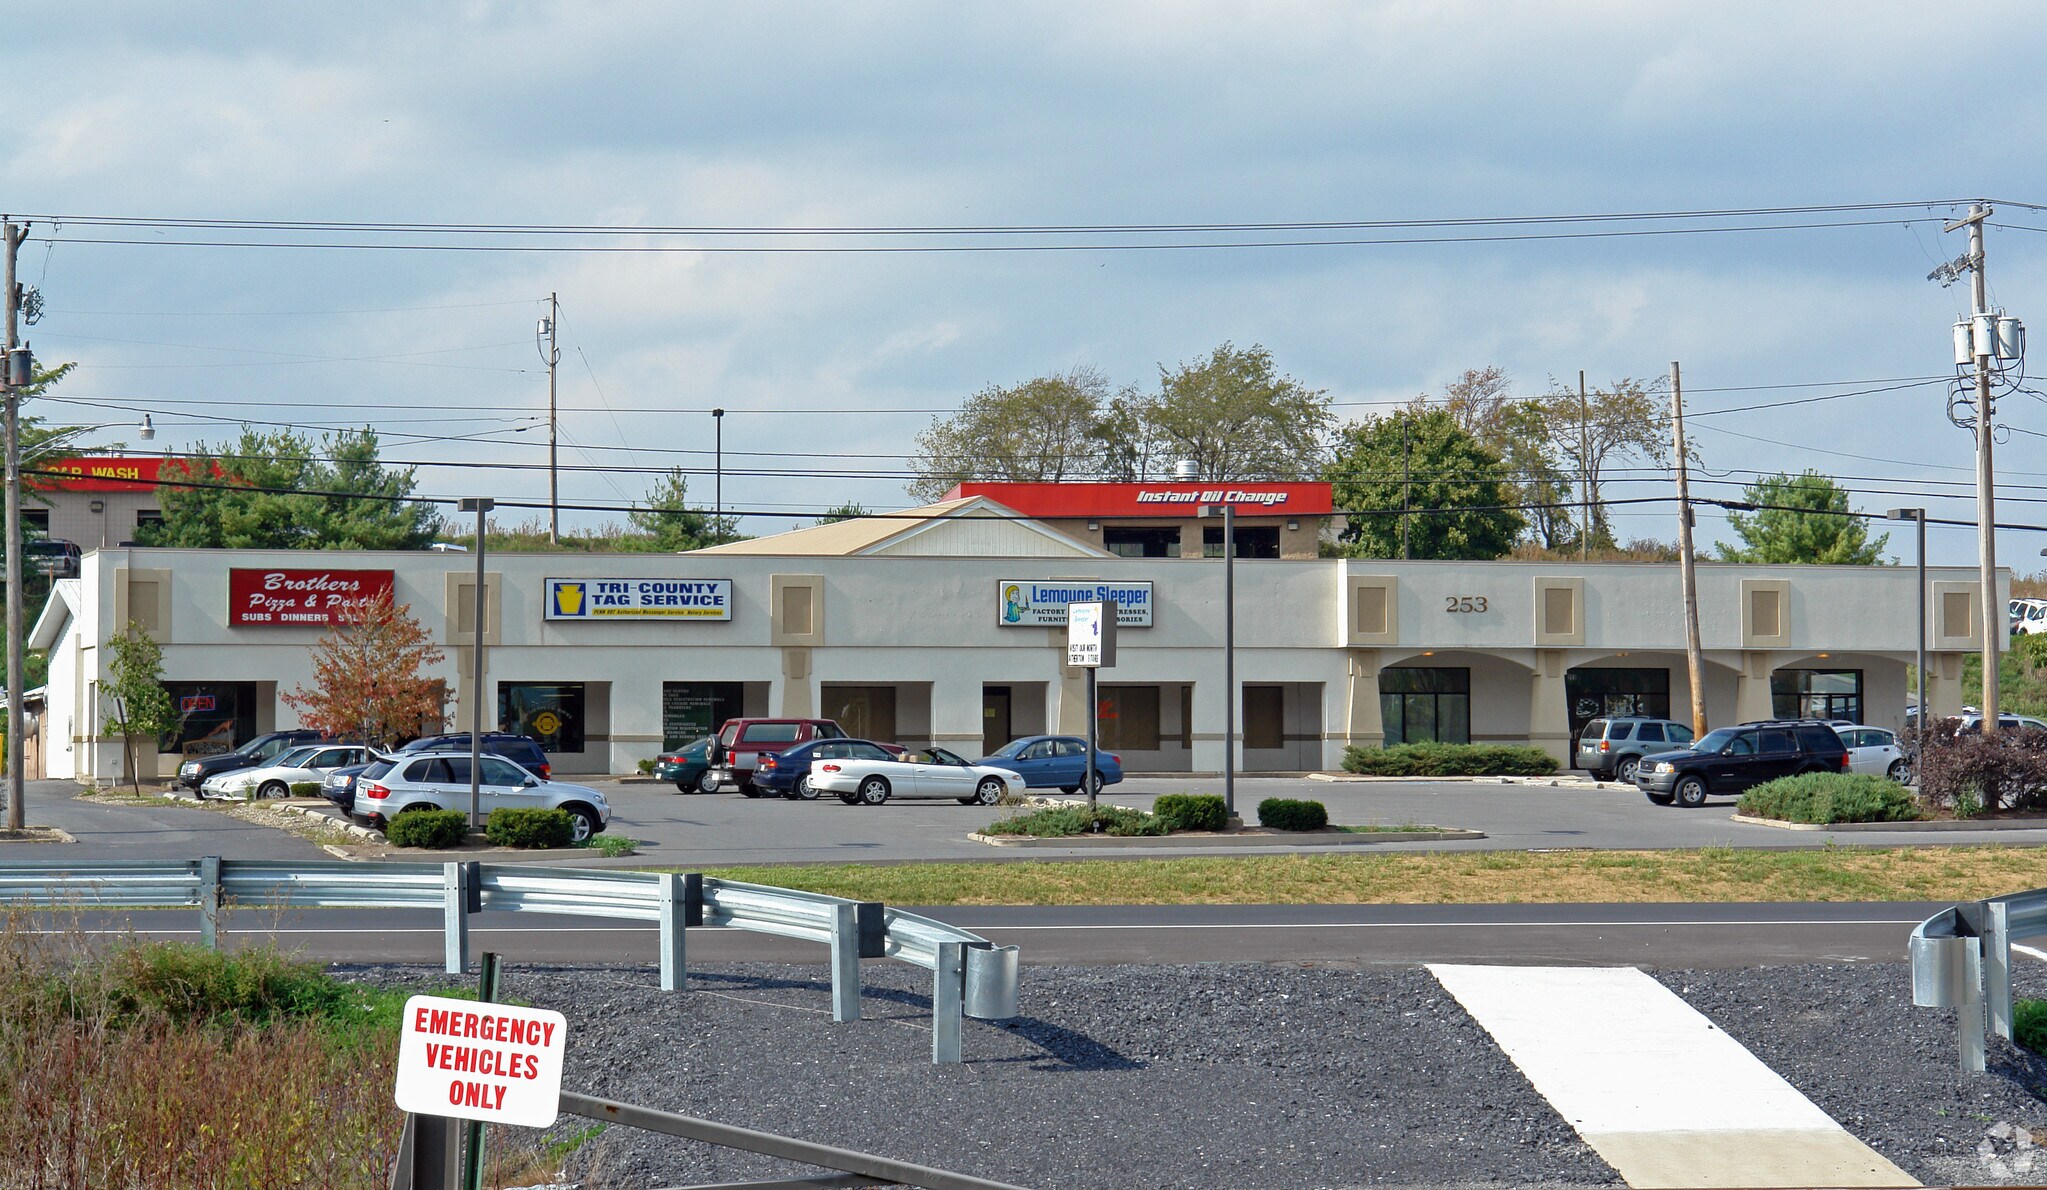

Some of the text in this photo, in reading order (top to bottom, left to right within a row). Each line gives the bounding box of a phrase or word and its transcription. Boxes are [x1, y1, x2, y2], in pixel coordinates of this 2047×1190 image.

[91, 467, 139, 480] WASH
[1136, 490, 1288, 505] Instant Oil Change
[263, 573, 360, 591] Brothers
[597, 582, 718, 594] TRI-COUNTY
[249, 593, 296, 611] Pizza
[304, 593, 318, 607] &
[592, 594, 724, 606] TAG SERVICE
[1096, 586, 1149, 608] Sleeper
[1445, 596, 1488, 613] 253
[241, 613, 272, 621] SUBS
[280, 613, 329, 622] DINNERS
[415, 1007, 556, 1047] EMERGENCY
[426, 1042, 539, 1080] VEHICLES
[448, 1080, 507, 1110] ONLY
